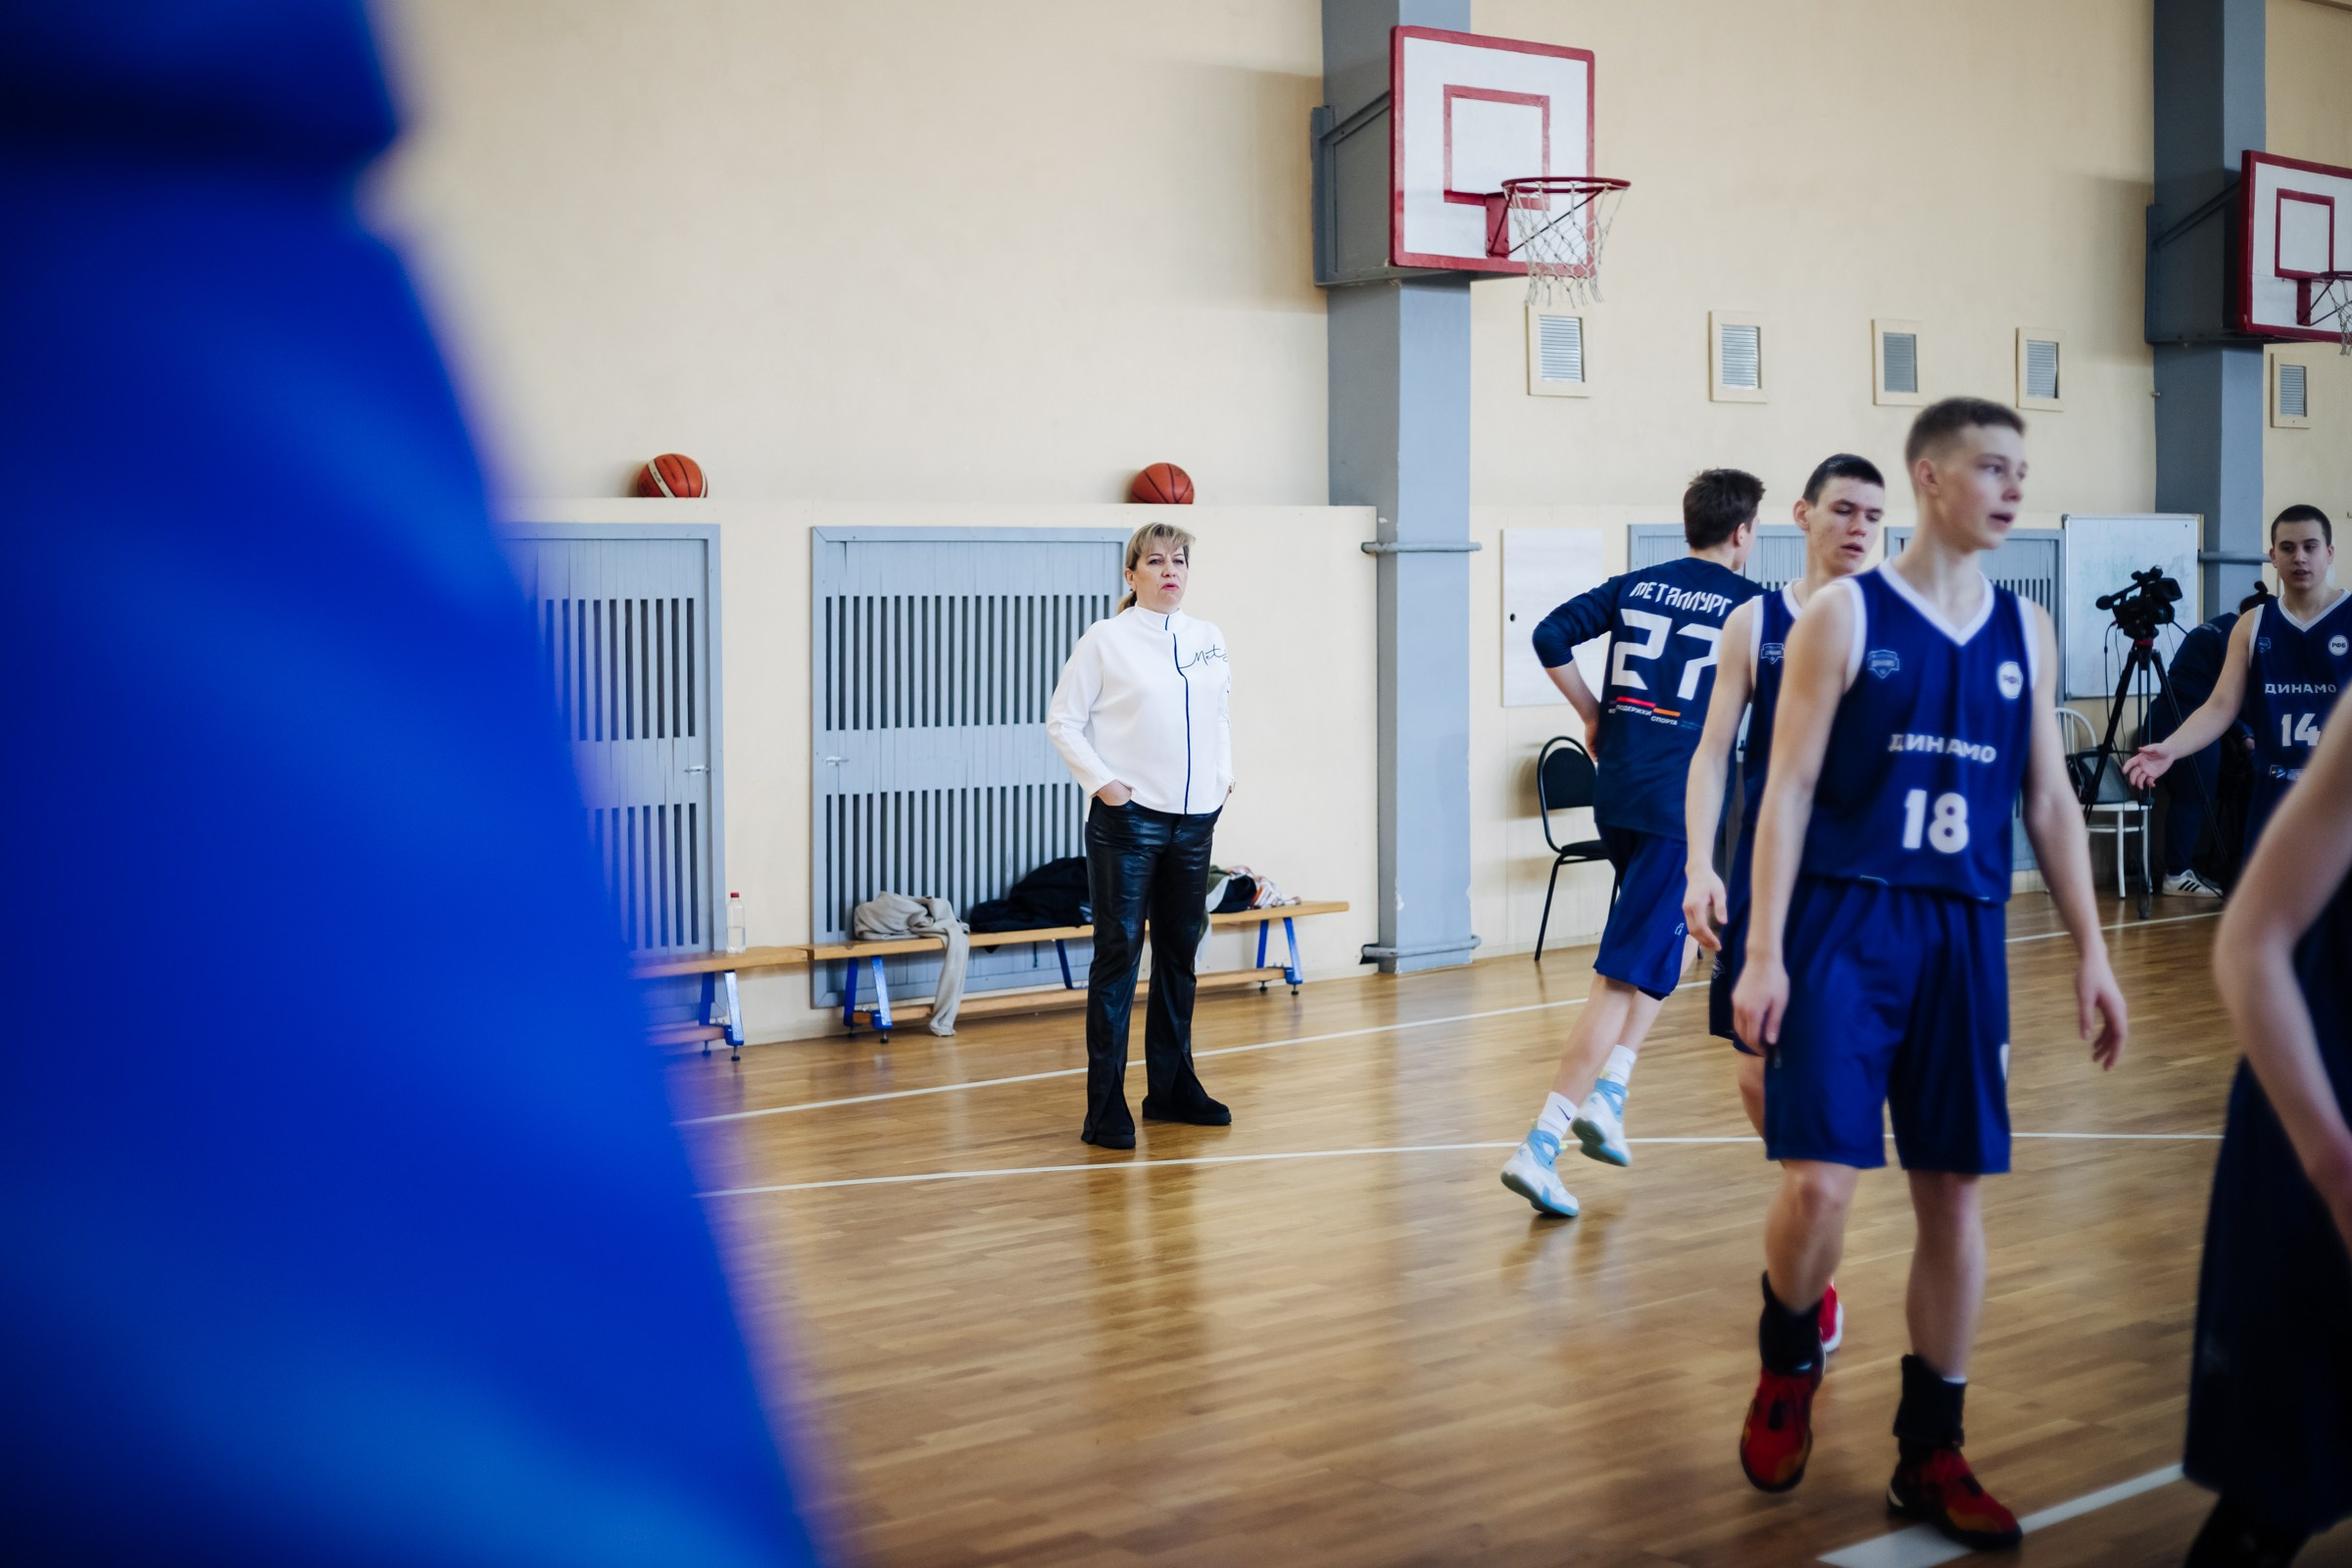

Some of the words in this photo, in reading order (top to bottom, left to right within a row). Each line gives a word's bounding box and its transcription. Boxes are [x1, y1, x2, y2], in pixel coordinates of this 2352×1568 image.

[1611, 608, 1723, 701] 27
[2265, 683, 2336, 695] ДИНАМО
[2280, 712, 2322, 747] 14
[1888, 733, 1997, 763] ДИНАМО
[1902, 789, 1970, 855] 18
